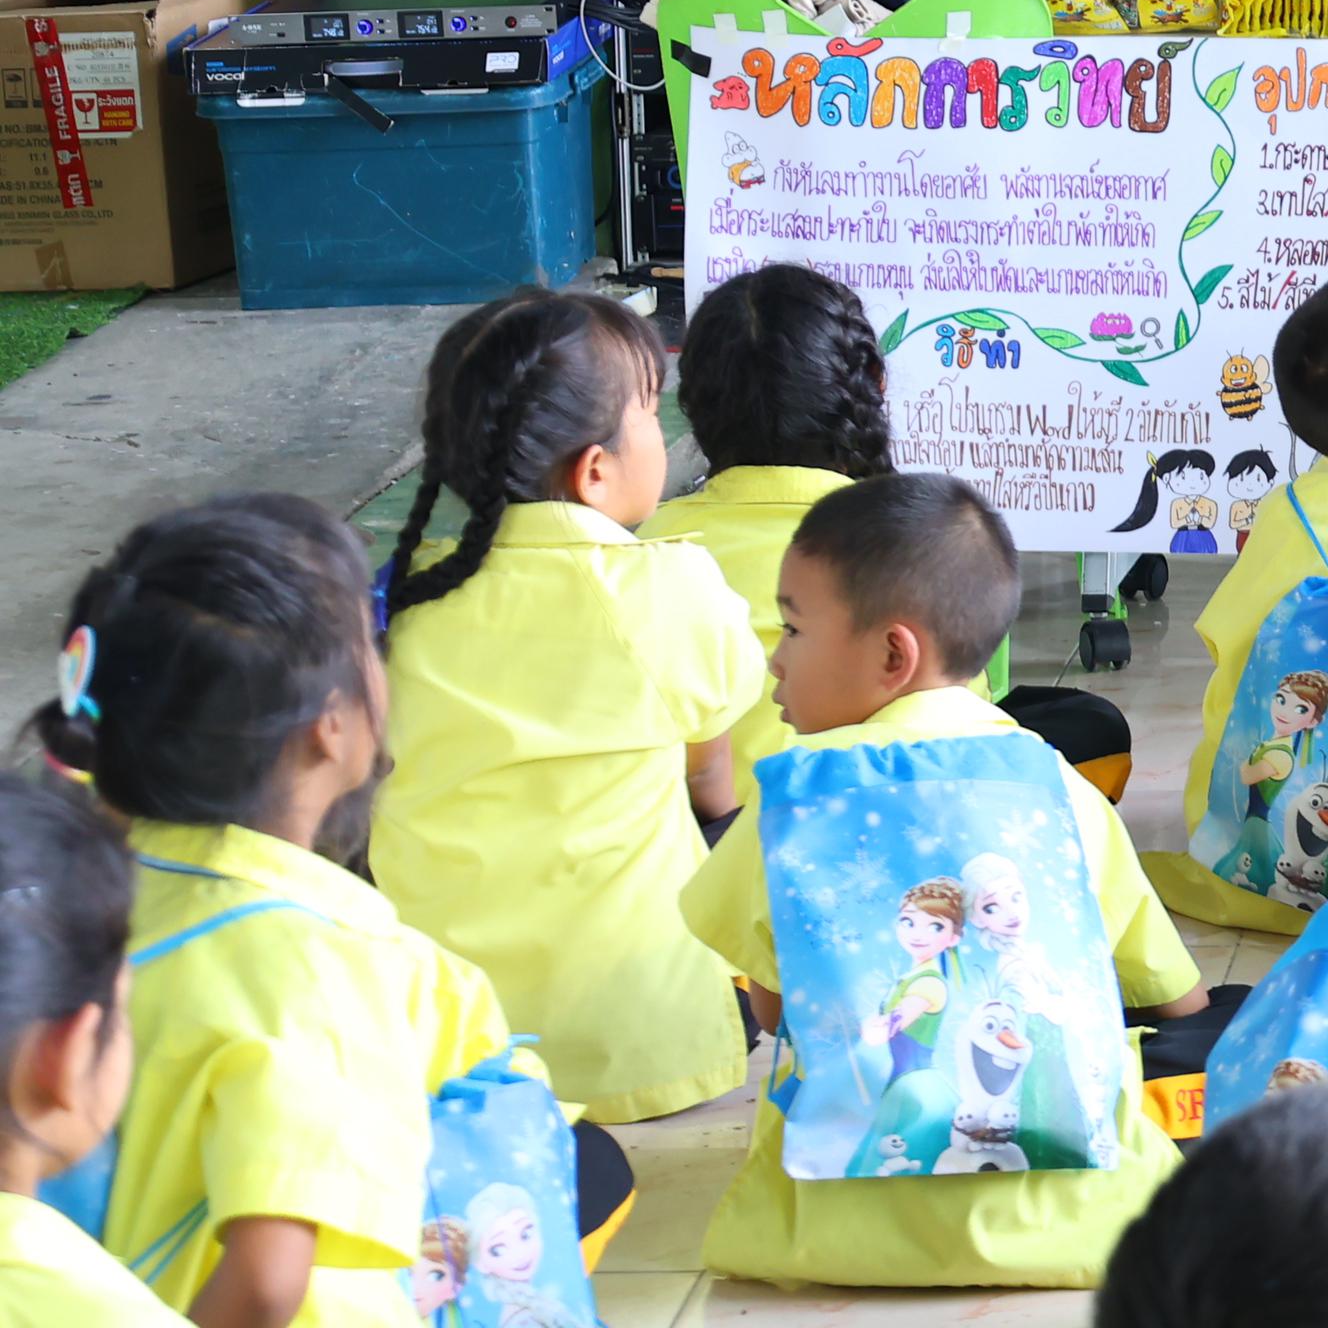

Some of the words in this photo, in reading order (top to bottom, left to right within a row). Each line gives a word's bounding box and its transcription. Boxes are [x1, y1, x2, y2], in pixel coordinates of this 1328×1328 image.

[45, 65, 73, 141] FRAGILE
[206, 70, 246, 82] vocal
[741, 37, 1194, 133] หลักการวิทย์
